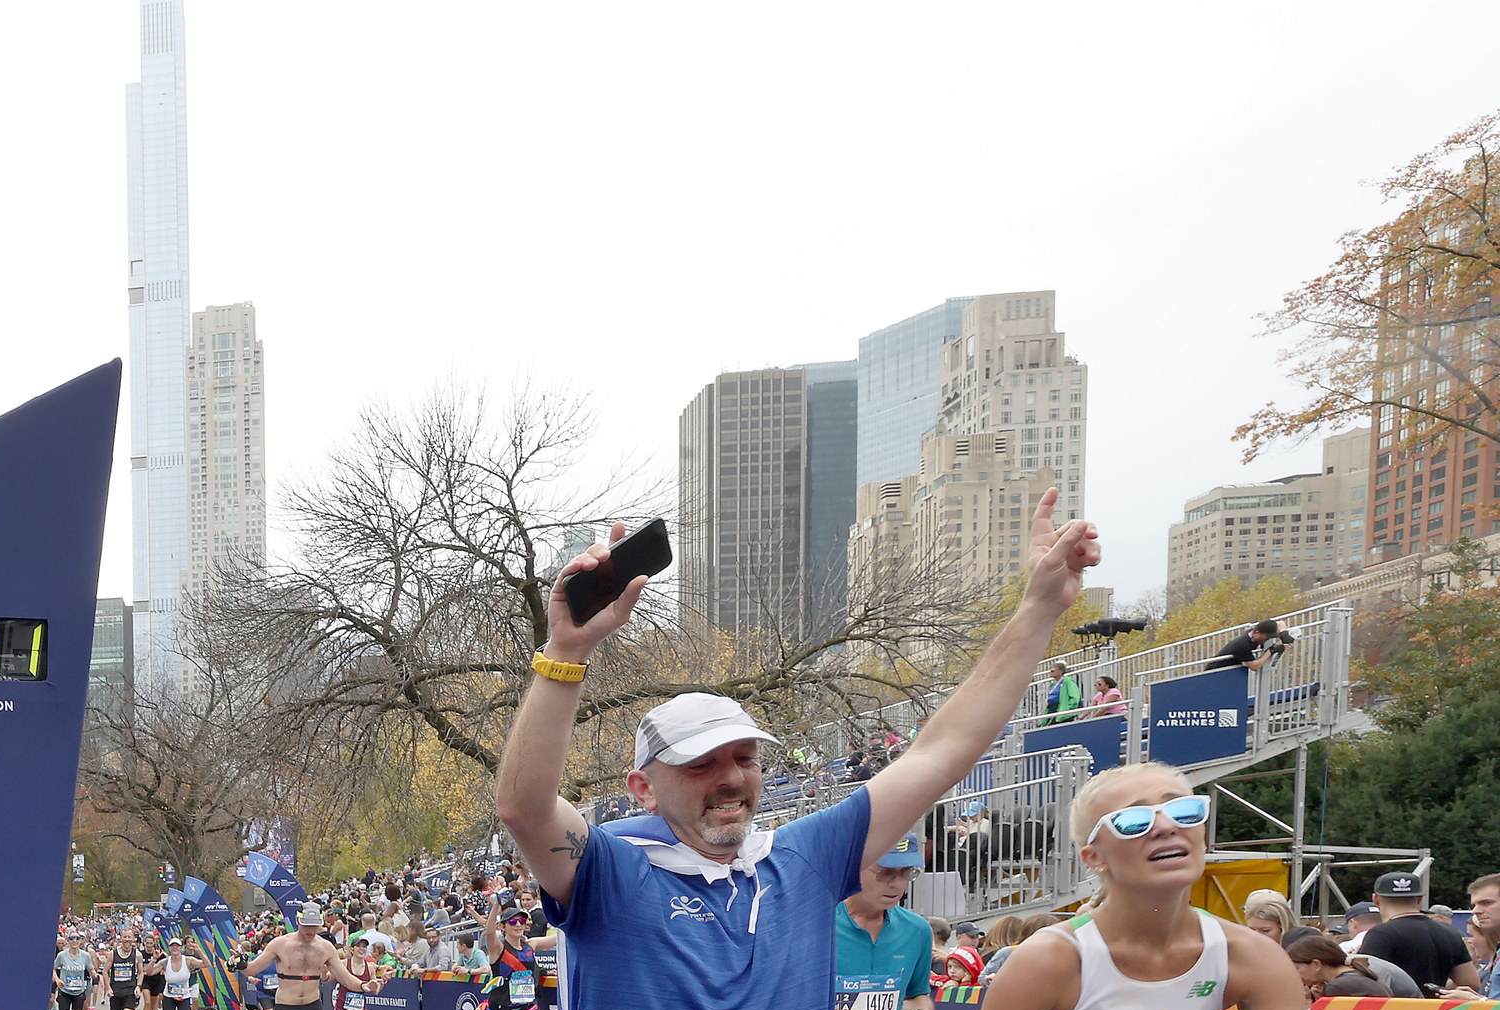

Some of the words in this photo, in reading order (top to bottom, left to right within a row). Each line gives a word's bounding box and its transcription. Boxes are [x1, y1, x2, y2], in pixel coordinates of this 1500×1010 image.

[1169, 711, 1216, 719] UNITED
[1156, 718, 1216, 727] AIRLINES
[844, 980, 859, 990] tcs
[867, 993, 894, 1010] 14176
